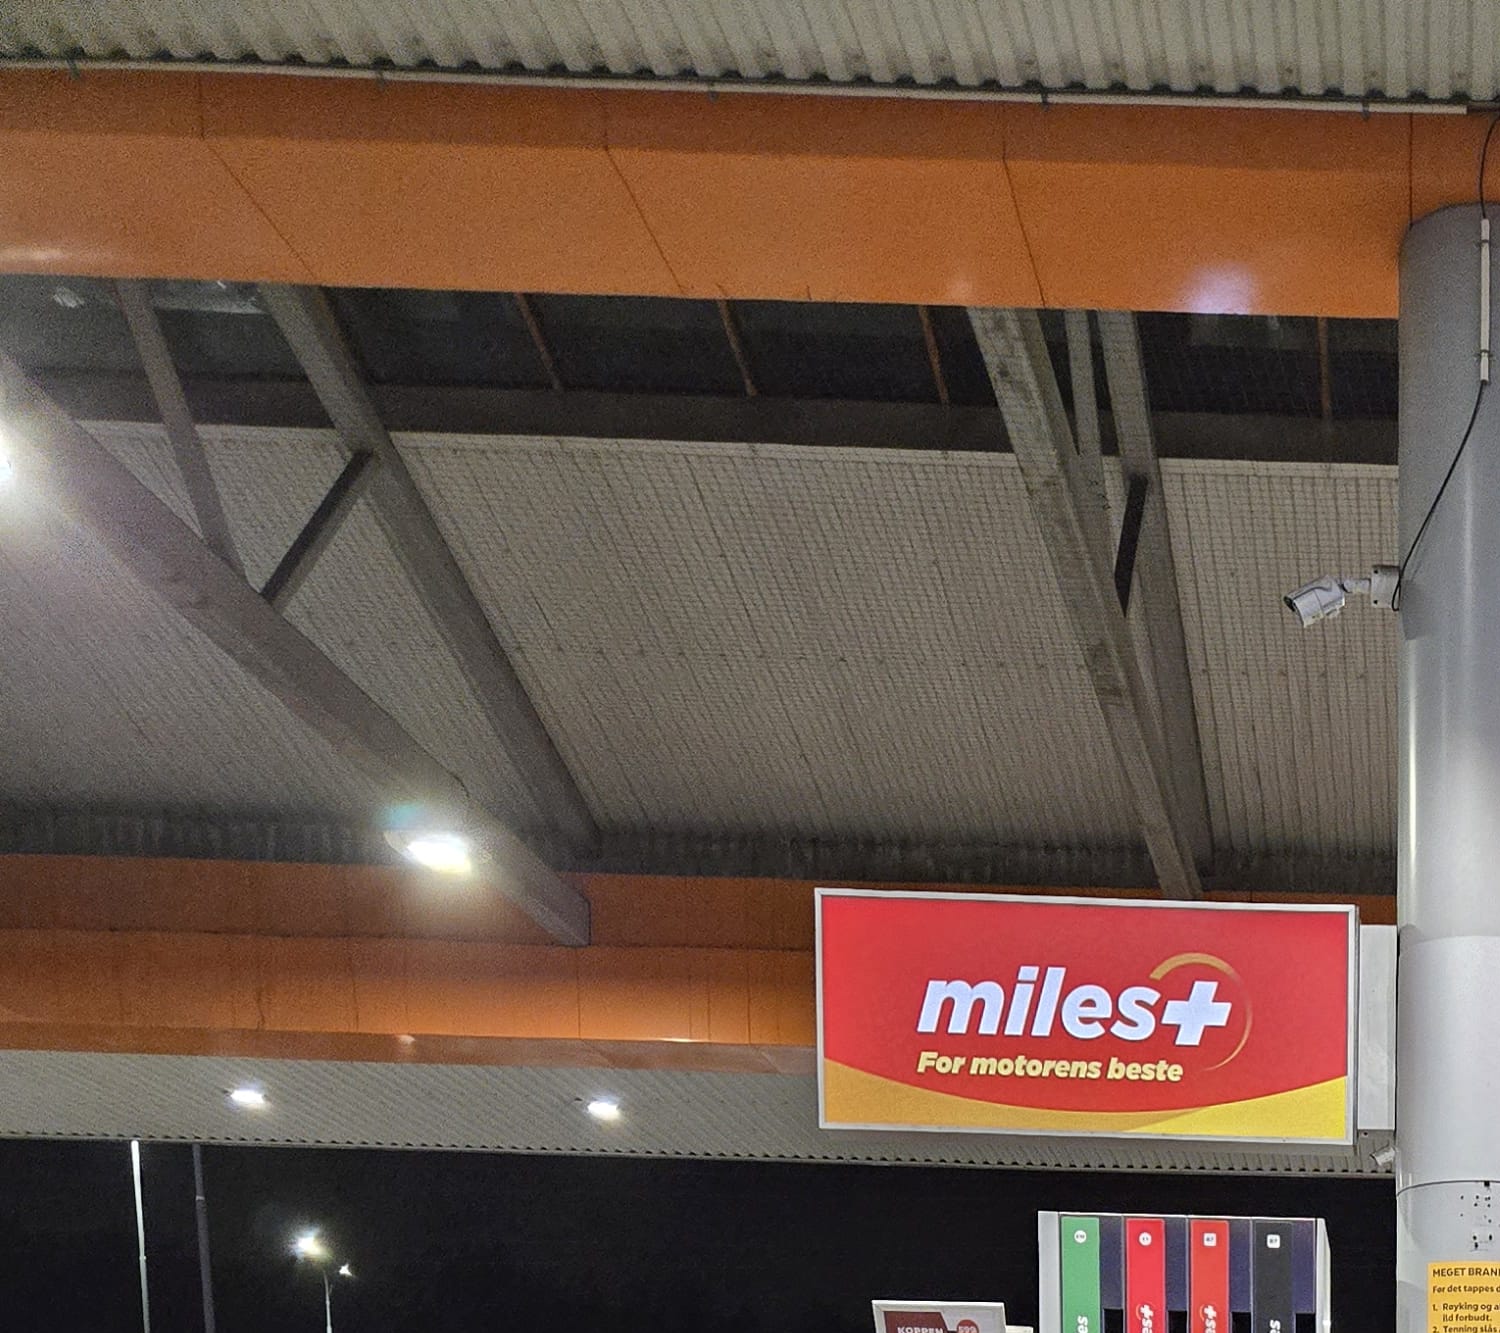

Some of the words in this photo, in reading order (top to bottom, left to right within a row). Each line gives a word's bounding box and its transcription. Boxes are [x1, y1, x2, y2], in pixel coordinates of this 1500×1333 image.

[916, 965, 1233, 1046] miles+
[917, 1051, 966, 1074] For
[969, 1054, 1102, 1079] motorens
[1106, 1057, 1184, 1082] beste
[1432, 1267, 1466, 1277] MEGET
[1447, 1285, 1462, 1293] det
[1463, 1285, 1494, 1295] tappes
[1442, 1303, 1479, 1313] Røyking
[1481, 1304, 1492, 1312] og
[1442, 1313, 1455, 1322] ild
[1455, 1313, 1493, 1322] forbudt.
[1480, 1324, 1497, 1333] slås
